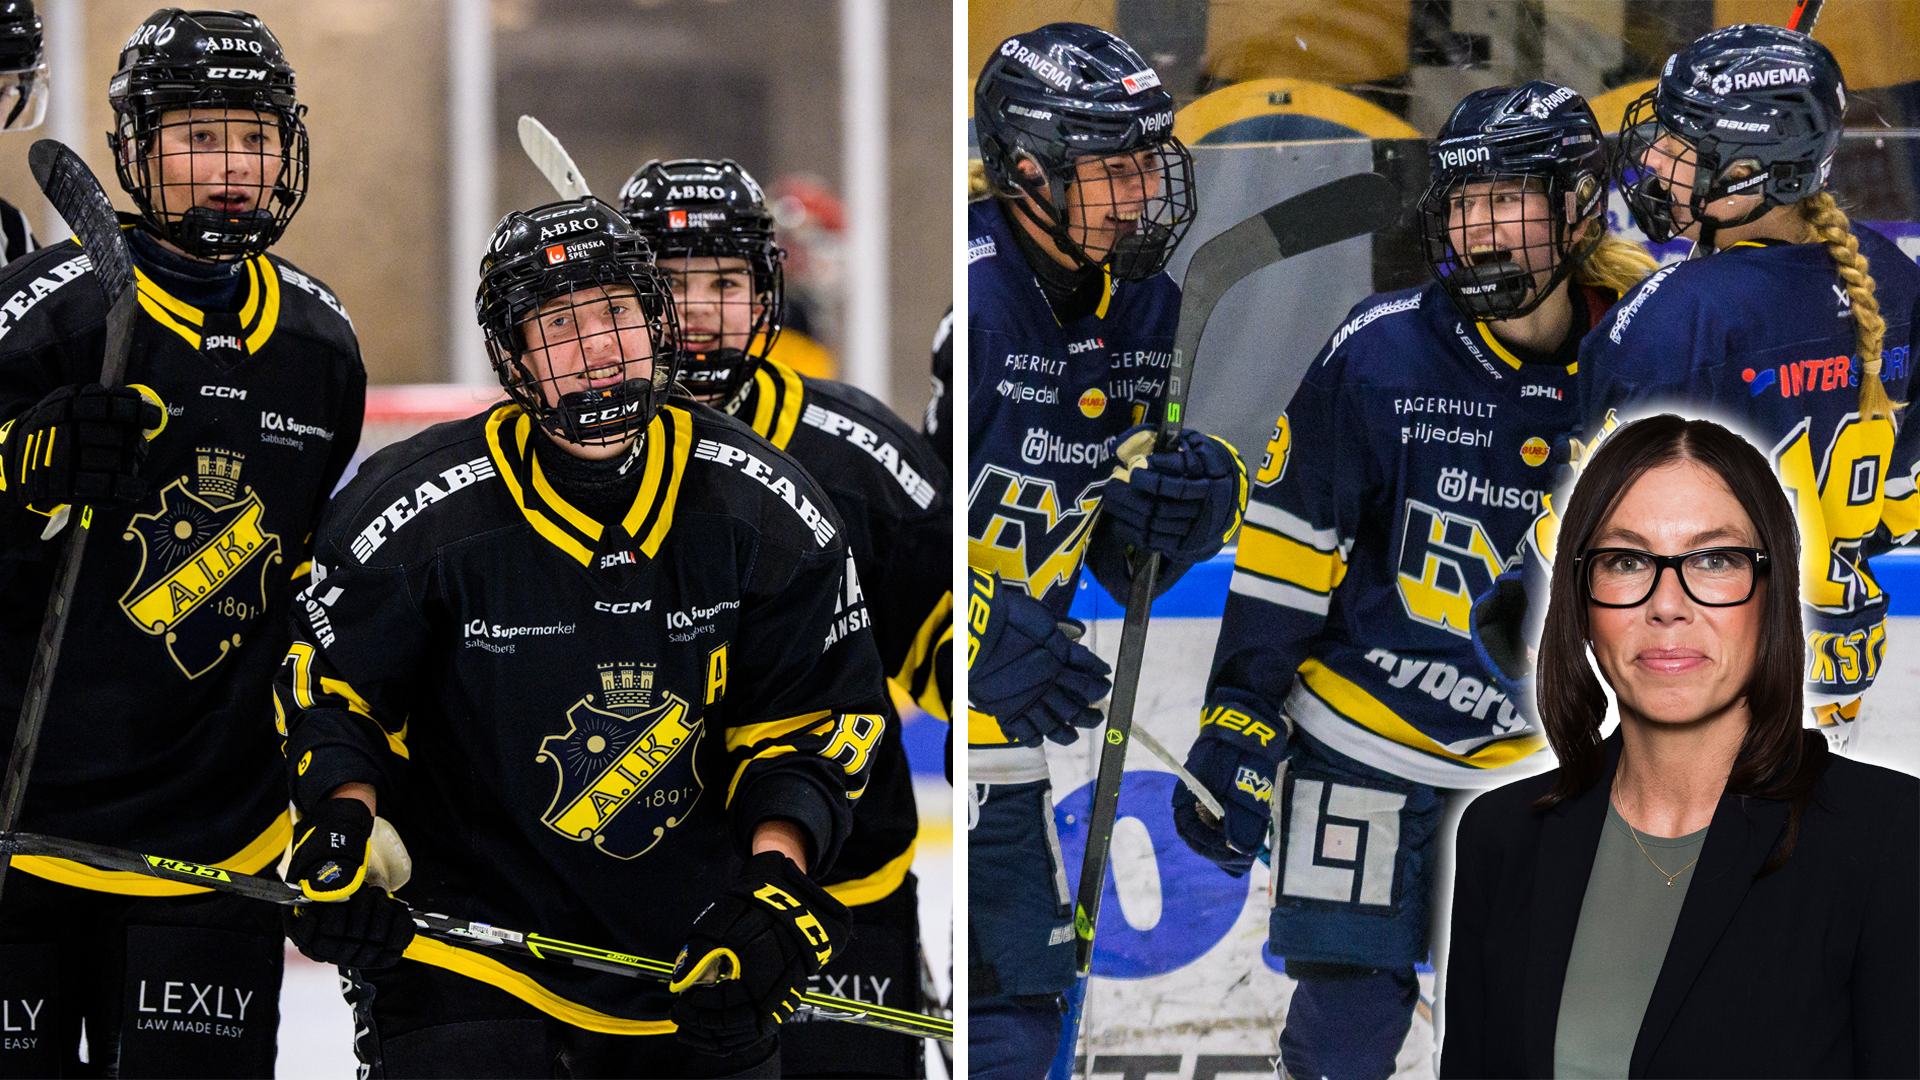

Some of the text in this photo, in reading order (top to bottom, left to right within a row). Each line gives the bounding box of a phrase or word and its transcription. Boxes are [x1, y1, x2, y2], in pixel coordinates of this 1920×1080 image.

[207, 66, 268, 81] CCM
[1013, 46, 1073, 92] RAVEMA
[1734, 67, 1811, 91] RAVEMA
[110, 78, 129, 93] CCM
[1007, 104, 1053, 121] BAUER
[1138, 110, 1174, 136] Yellon
[1715, 118, 1771, 134] BAUER
[1438, 146, 1491, 170] Yellon
[1726, 171, 1770, 194] BAUER
[200, 230, 261, 245] CCM
[566, 239, 606, 254] SVENSKA
[567, 251, 590, 262] SPEL
[1459, 336, 1502, 380] BAUER
[200, 385, 248, 401] CCM
[579, 401, 639, 426] CCM
[1394, 396, 1498, 419] FAGERHULT
[260, 411, 285, 432] ICA
[260, 432, 304, 451] Sabbatsberg
[816, 405, 928, 498] PEAB
[1520, 446, 1550, 456] BUBS
[710, 442, 824, 535] PEAB
[363, 462, 479, 555] PEAB
[594, 600, 652, 615] CCM
[464, 620, 577, 639] ICA Supermarket
[666, 611, 693, 630] ICA
[702, 641, 730, 710] A
[138, 980, 253, 1021] LEXLY
[137, 1019, 244, 1039] LAW MADE EASY
[4, 1037, 38, 1050] EASY
